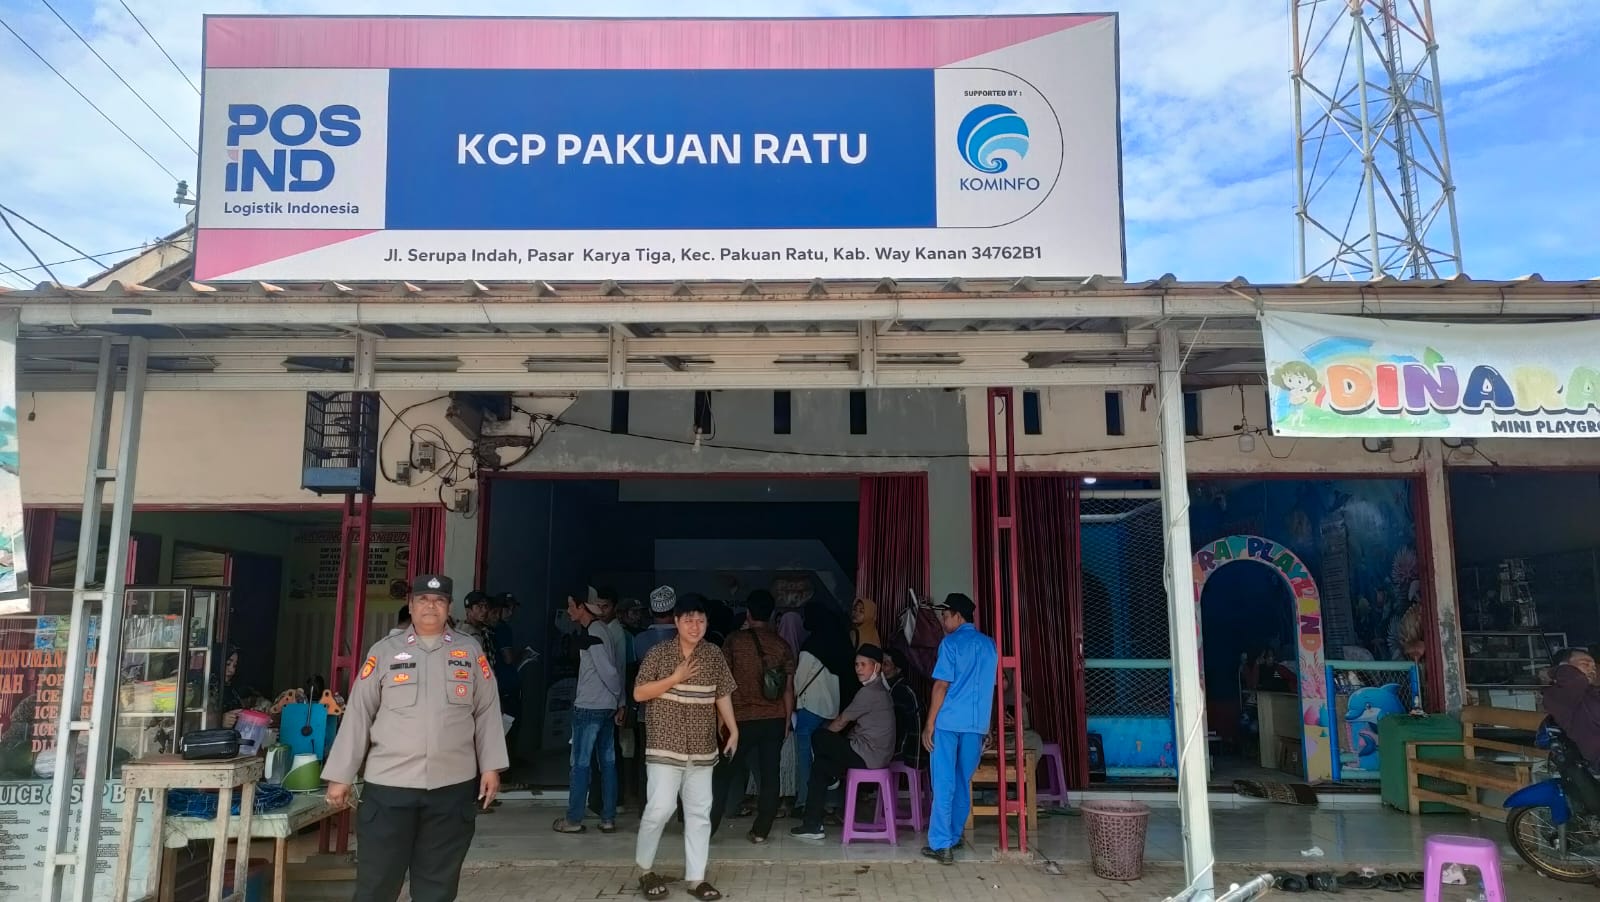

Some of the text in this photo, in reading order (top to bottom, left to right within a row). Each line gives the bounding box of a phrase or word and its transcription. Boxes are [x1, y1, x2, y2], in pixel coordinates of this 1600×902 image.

[227, 103, 362, 147] POS
[458, 133, 868, 165] KCP PAKUAN RATU
[960, 177, 1040, 191] KOMINFO
[224, 201, 360, 217] Logistik Indonesia
[407, 248, 467, 265] Serupa
[471, 248, 522, 264] Indah,
[527, 248, 575, 263] Pasar
[583, 248, 630, 265] Karya
[635, 247, 676, 265] Tiga,
[681, 247, 716, 262] Kec.
[720, 247, 781, 262] Pakuan
[786, 247, 828, 264] Ratu,
[833, 247, 871, 261] Kab.
[875, 247, 911, 263] Way
[915, 247, 967, 261] Kanan
[971, 246, 1042, 261] 34762B1
[1491, 420, 1533, 434] MINI
[36, 689, 60, 703] ICE
[34, 706, 58, 719] ICE
[33, 723, 57, 737] ICE
